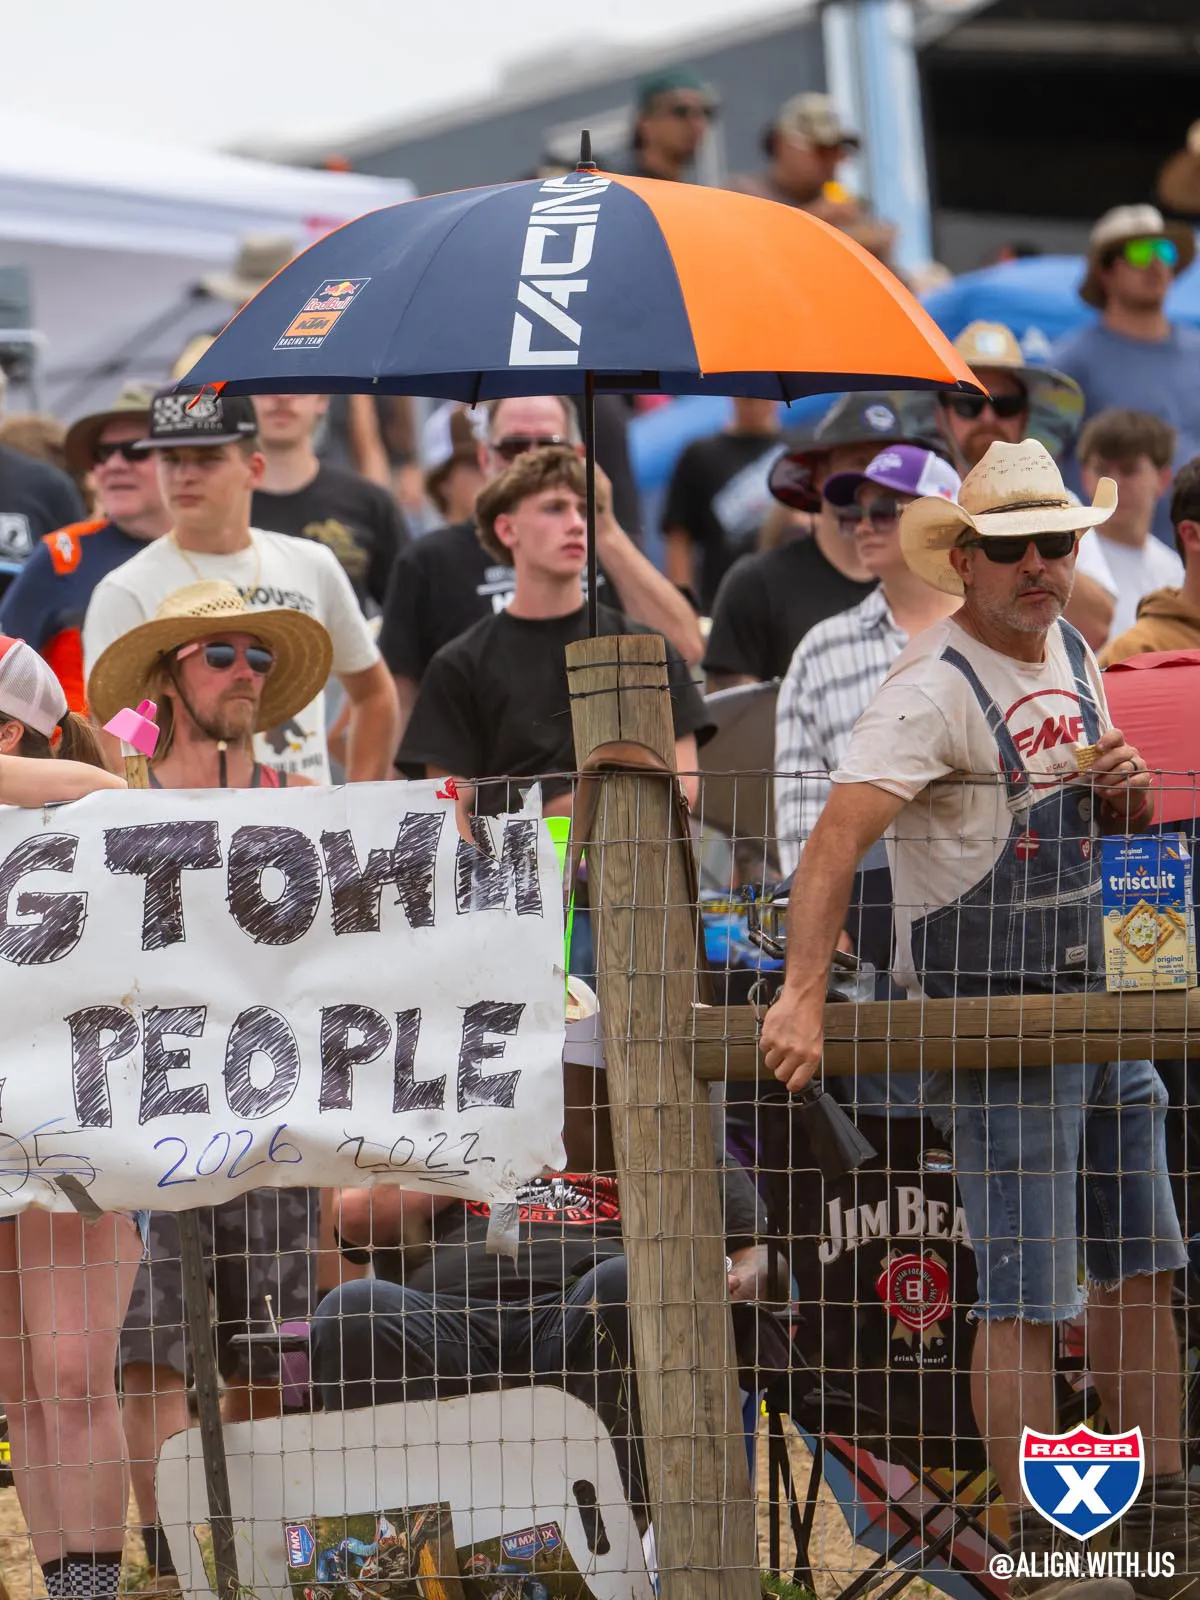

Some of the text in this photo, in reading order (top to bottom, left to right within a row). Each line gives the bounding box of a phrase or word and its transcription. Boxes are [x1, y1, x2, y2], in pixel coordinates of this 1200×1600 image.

[278, 336, 324, 346] RACING TEAM
[1109, 870, 1176, 891] triscuit
[1157, 954, 1184, 964] original
[64, 1000, 526, 1128] PEOPLE
[153, 1123, 302, 1188] 2026
[818, 1186, 975, 1265] JIM BEA
[906, 1280, 923, 1301] B
[290, 1530, 303, 1564] WMX
[504, 1534, 535, 1550] WMX
